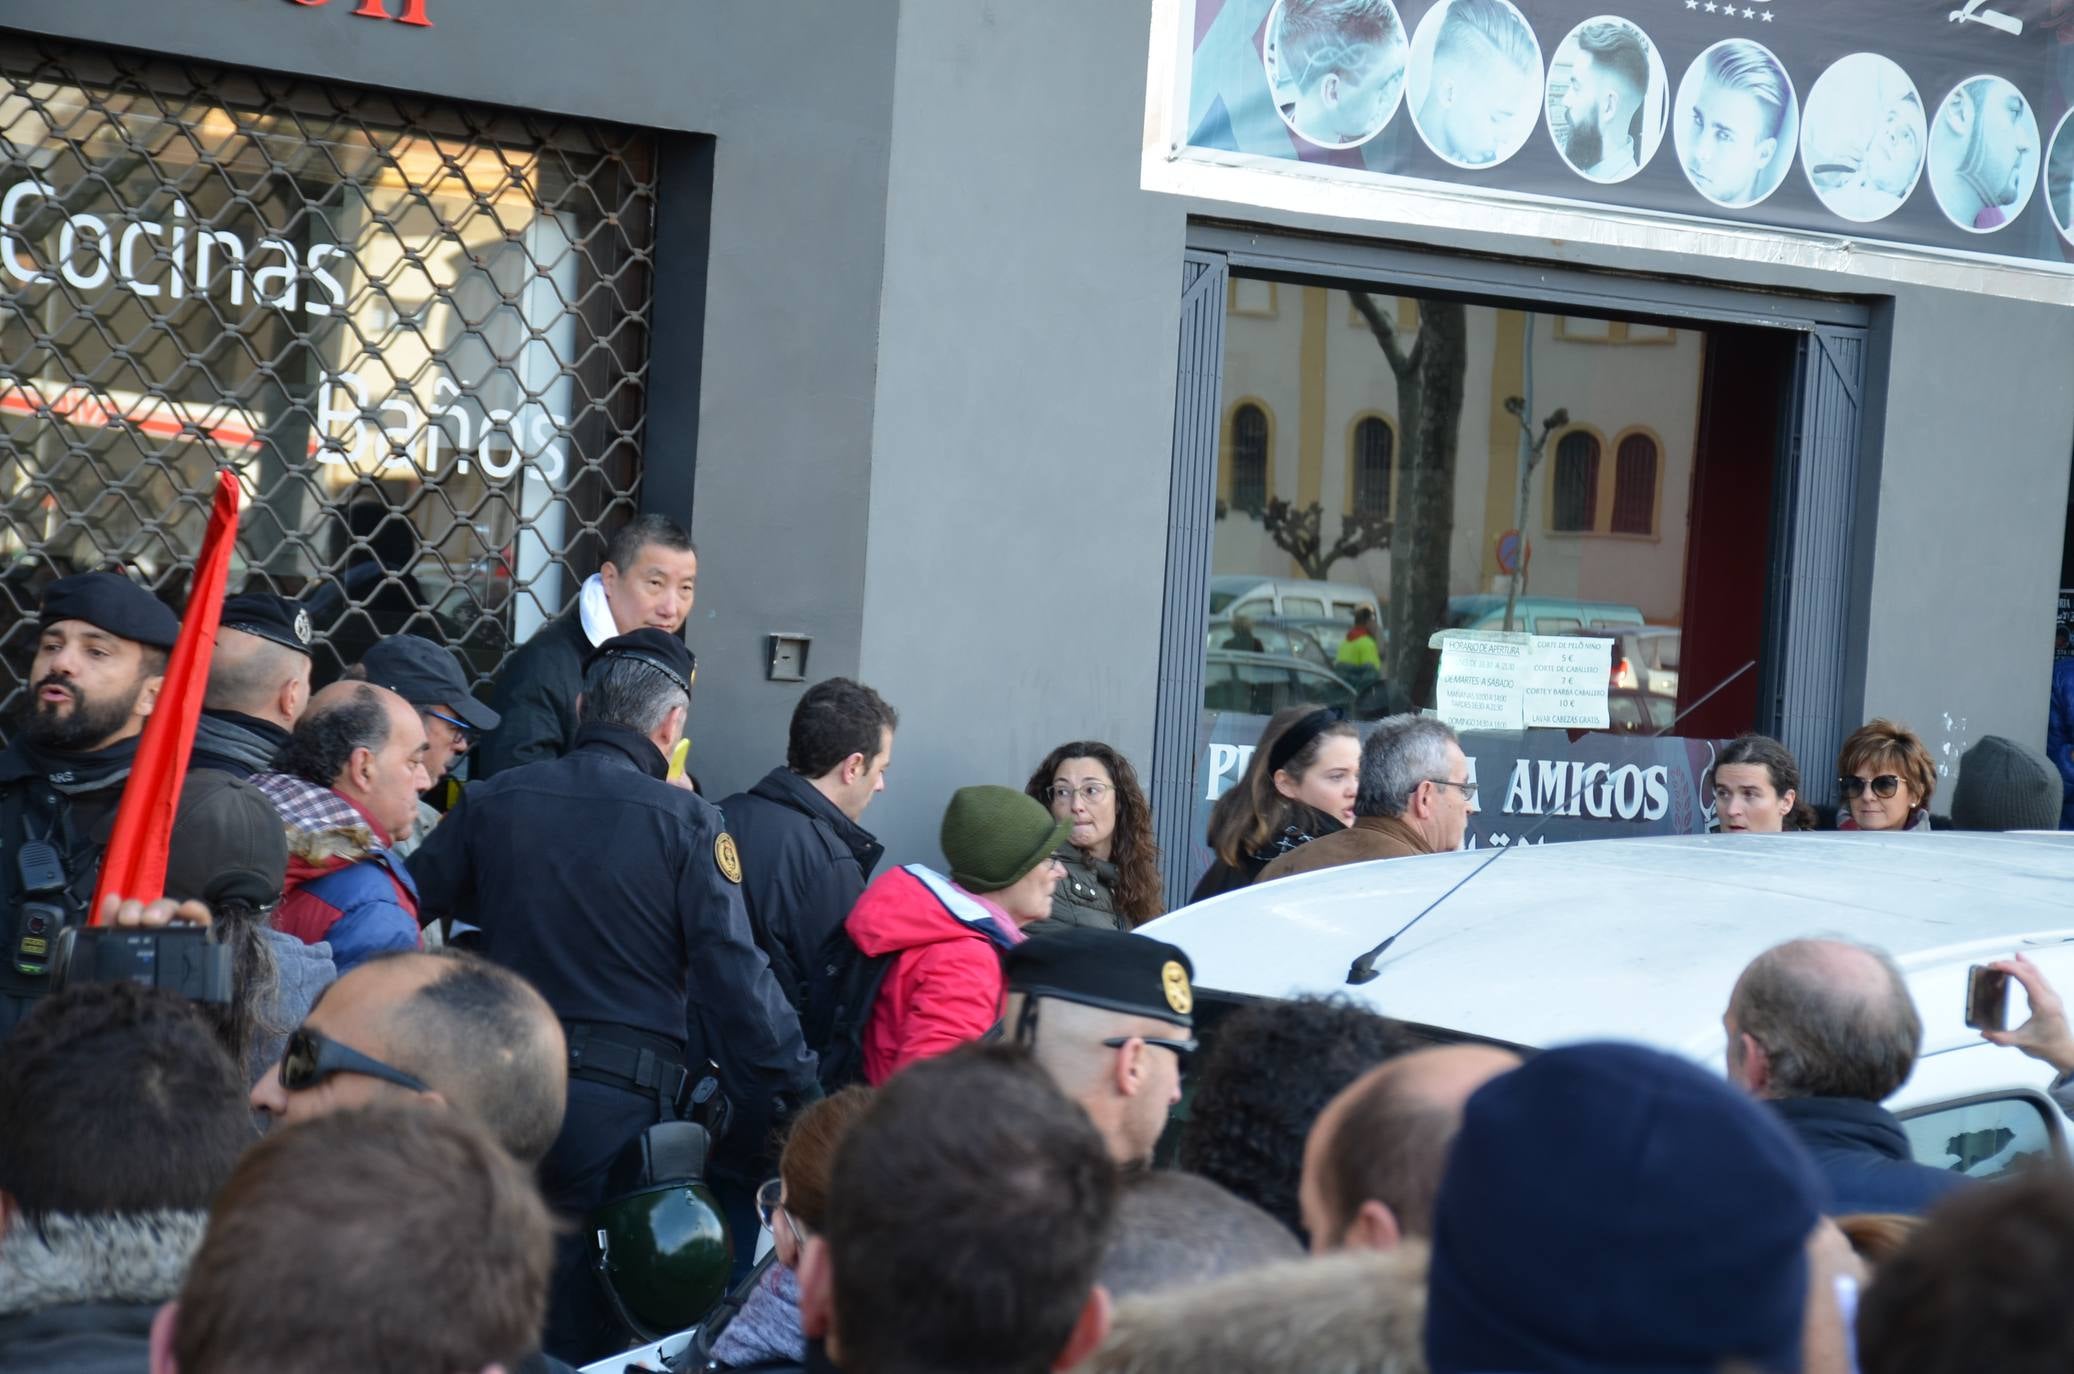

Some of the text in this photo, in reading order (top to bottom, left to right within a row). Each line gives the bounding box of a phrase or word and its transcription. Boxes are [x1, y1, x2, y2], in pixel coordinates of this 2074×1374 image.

[1, 179, 347, 316] Cocinas
[316, 370, 565, 482] Baños
[1454, 676, 1480, 685] MARTES
[1503, 758, 1669, 820] AMIGOS
